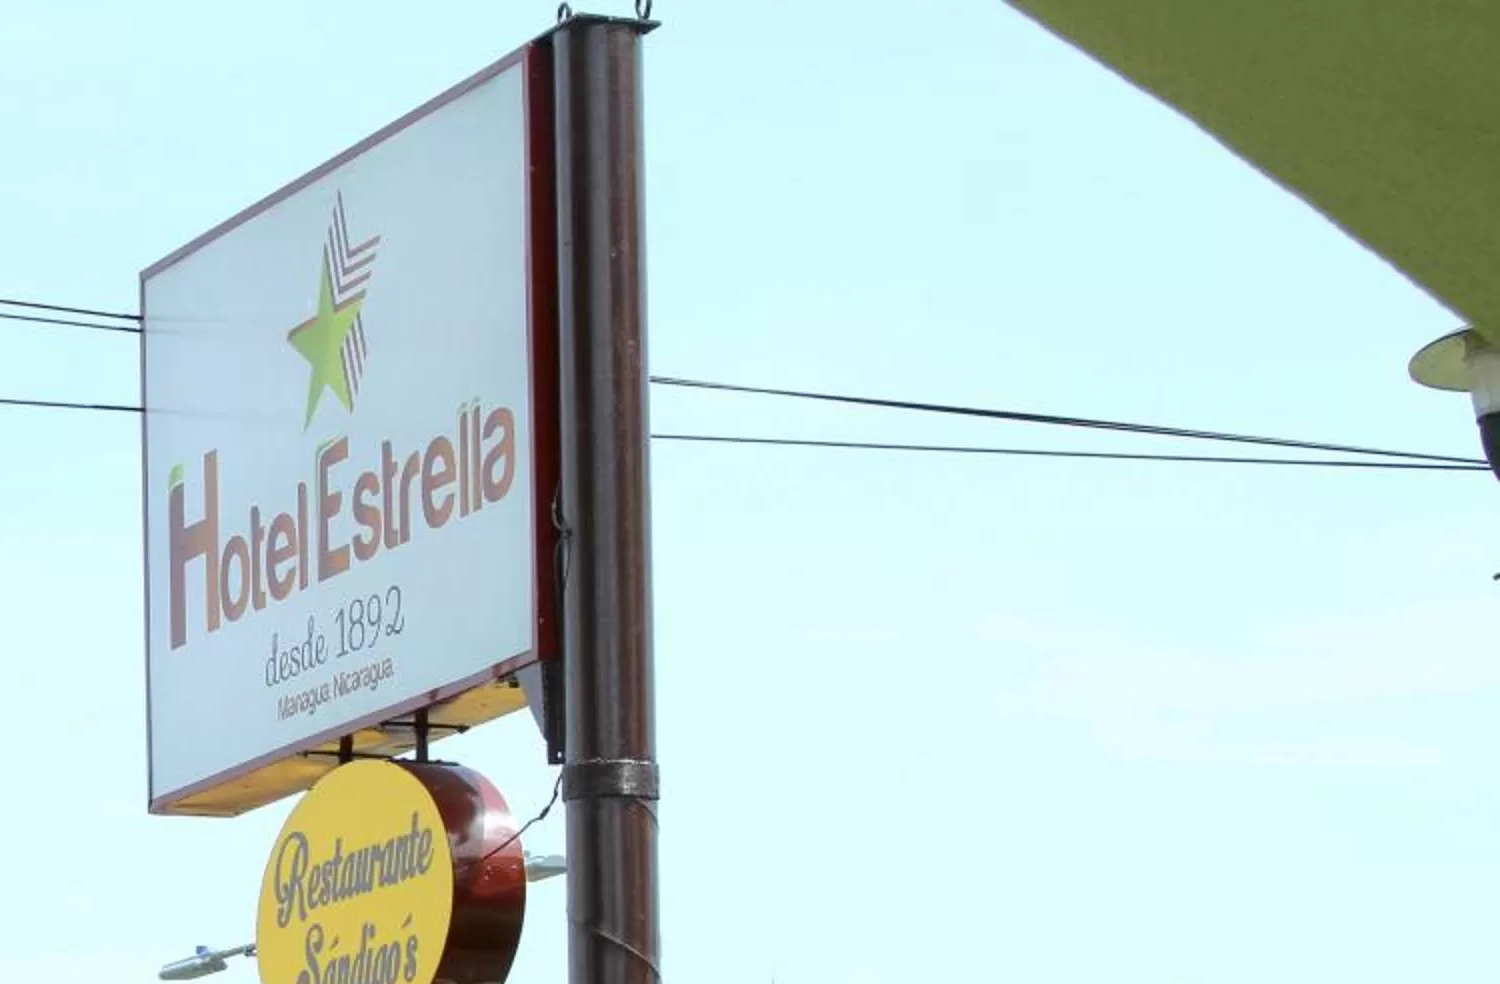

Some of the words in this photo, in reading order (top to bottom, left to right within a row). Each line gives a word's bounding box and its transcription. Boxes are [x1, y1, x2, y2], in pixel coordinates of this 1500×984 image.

[168, 449, 308, 650] Hotel
[315, 400, 515, 583] Estrella
[265, 615, 329, 688] desde
[334, 584, 405, 659] 1892
[274, 811, 435, 929] Restaurante
